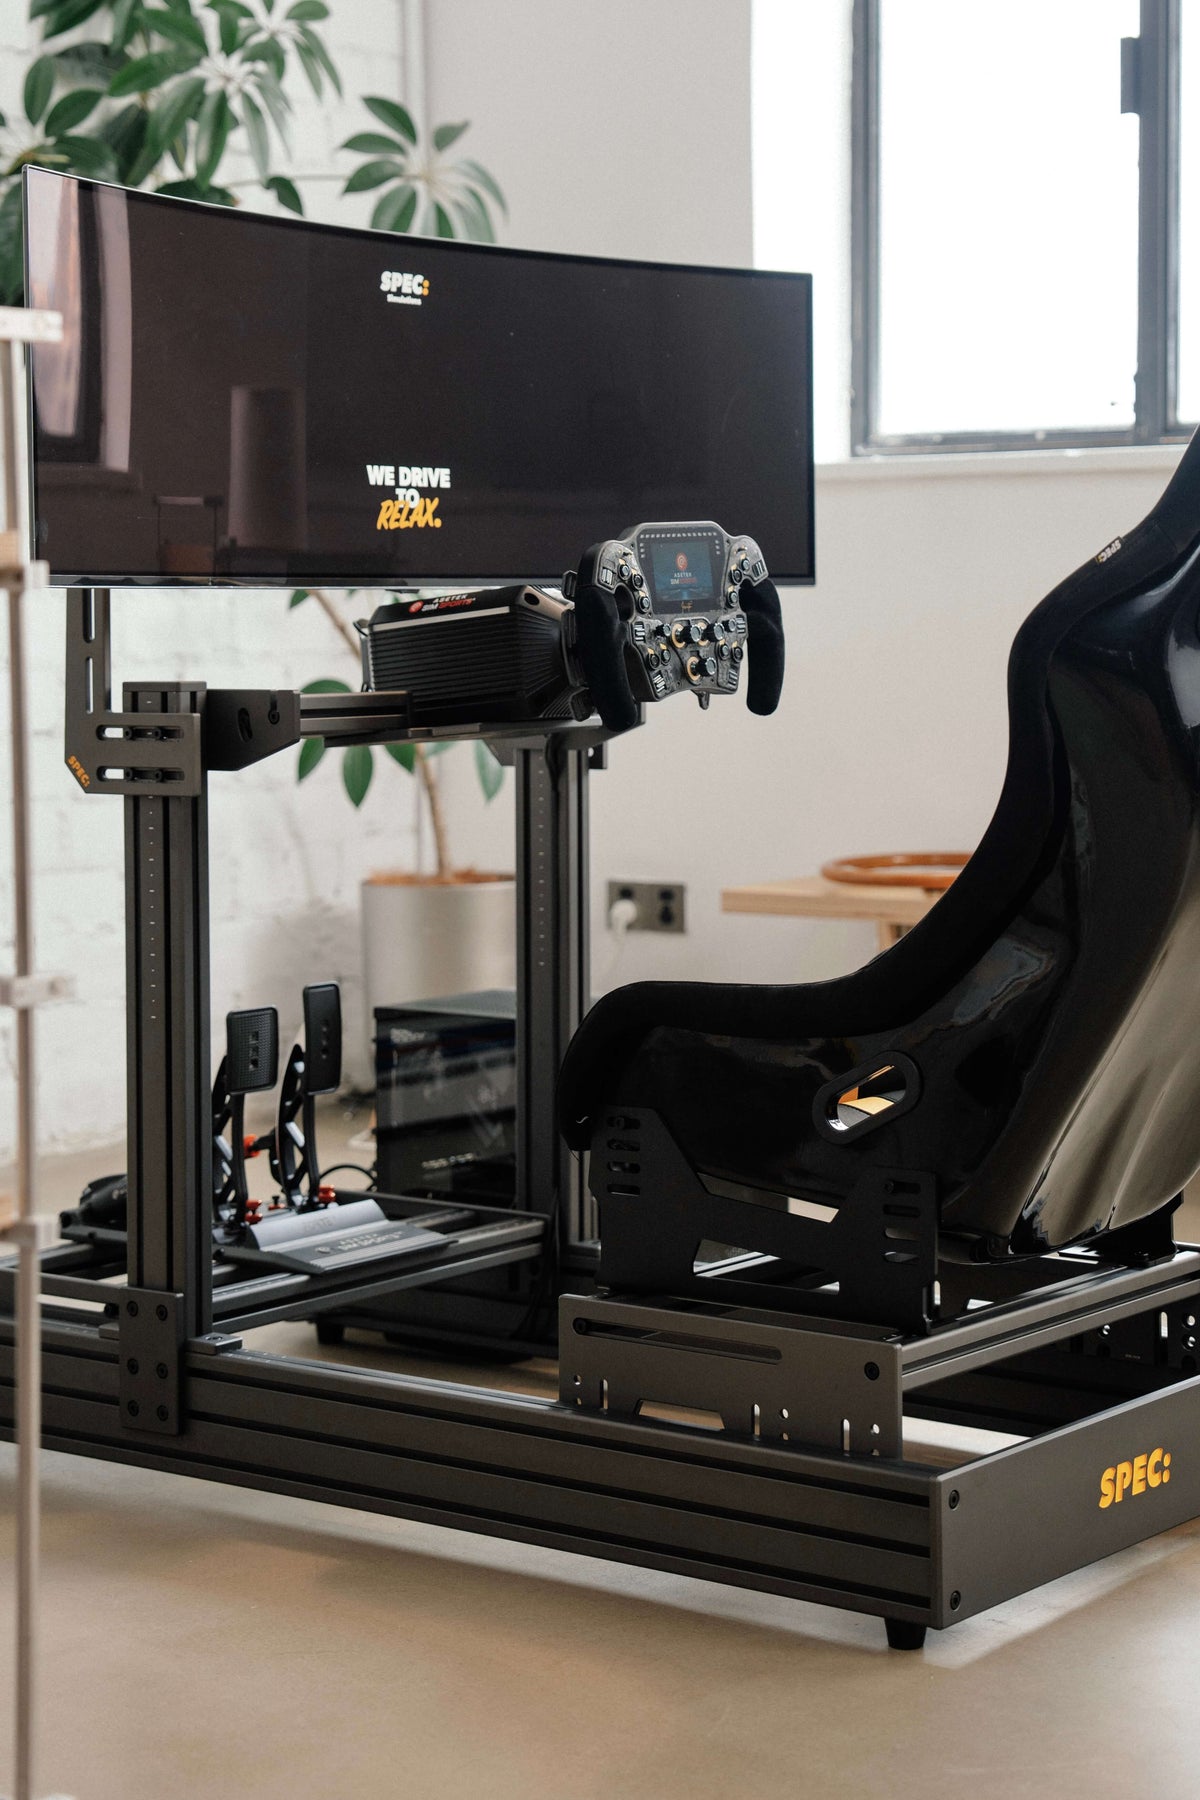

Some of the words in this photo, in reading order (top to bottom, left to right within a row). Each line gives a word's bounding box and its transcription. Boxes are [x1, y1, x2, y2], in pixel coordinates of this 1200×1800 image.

[380, 270, 430, 297] SPEC:
[366, 464, 396, 487] WE
[398, 466, 452, 489] DRIVE
[395, 487, 420, 509] TO
[376, 496, 443, 531] RELAX.
[1098, 1446, 1172, 1509] SPEC:
